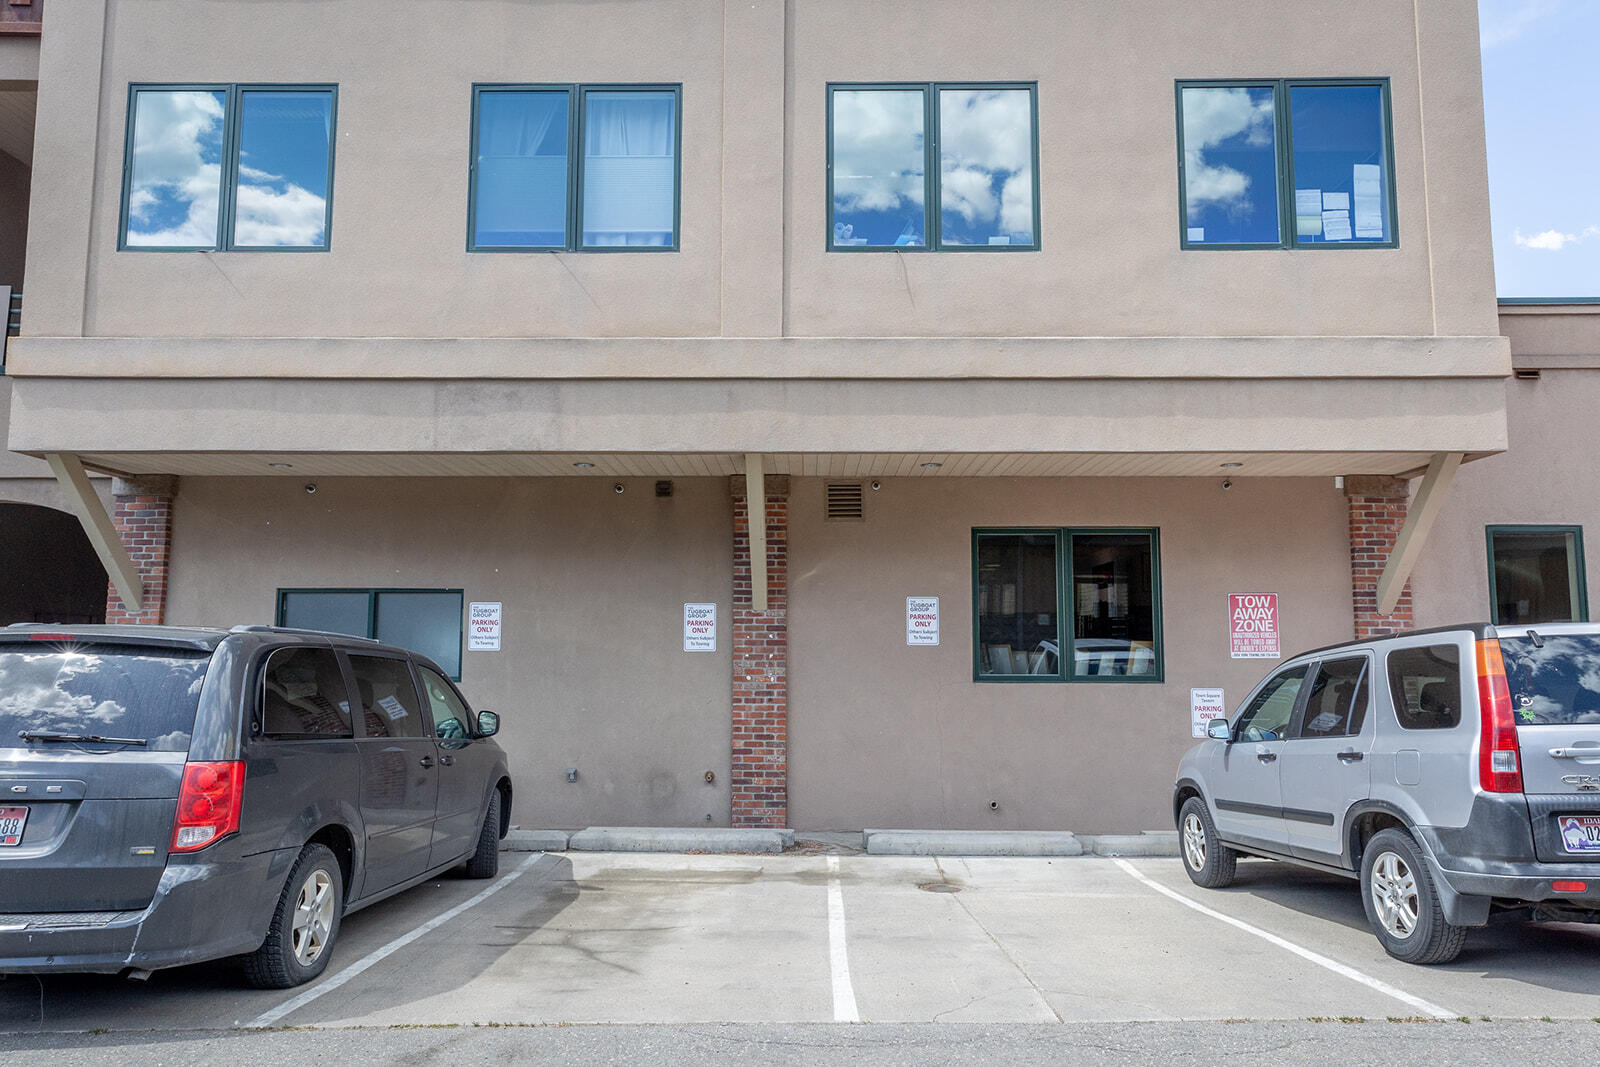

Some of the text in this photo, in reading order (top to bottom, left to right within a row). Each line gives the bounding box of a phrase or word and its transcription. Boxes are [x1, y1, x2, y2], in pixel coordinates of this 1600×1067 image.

[1235, 596, 1270, 608] TOW
[1233, 608, 1274, 620] AWAY
[1235, 620, 1274, 632] ZONE
